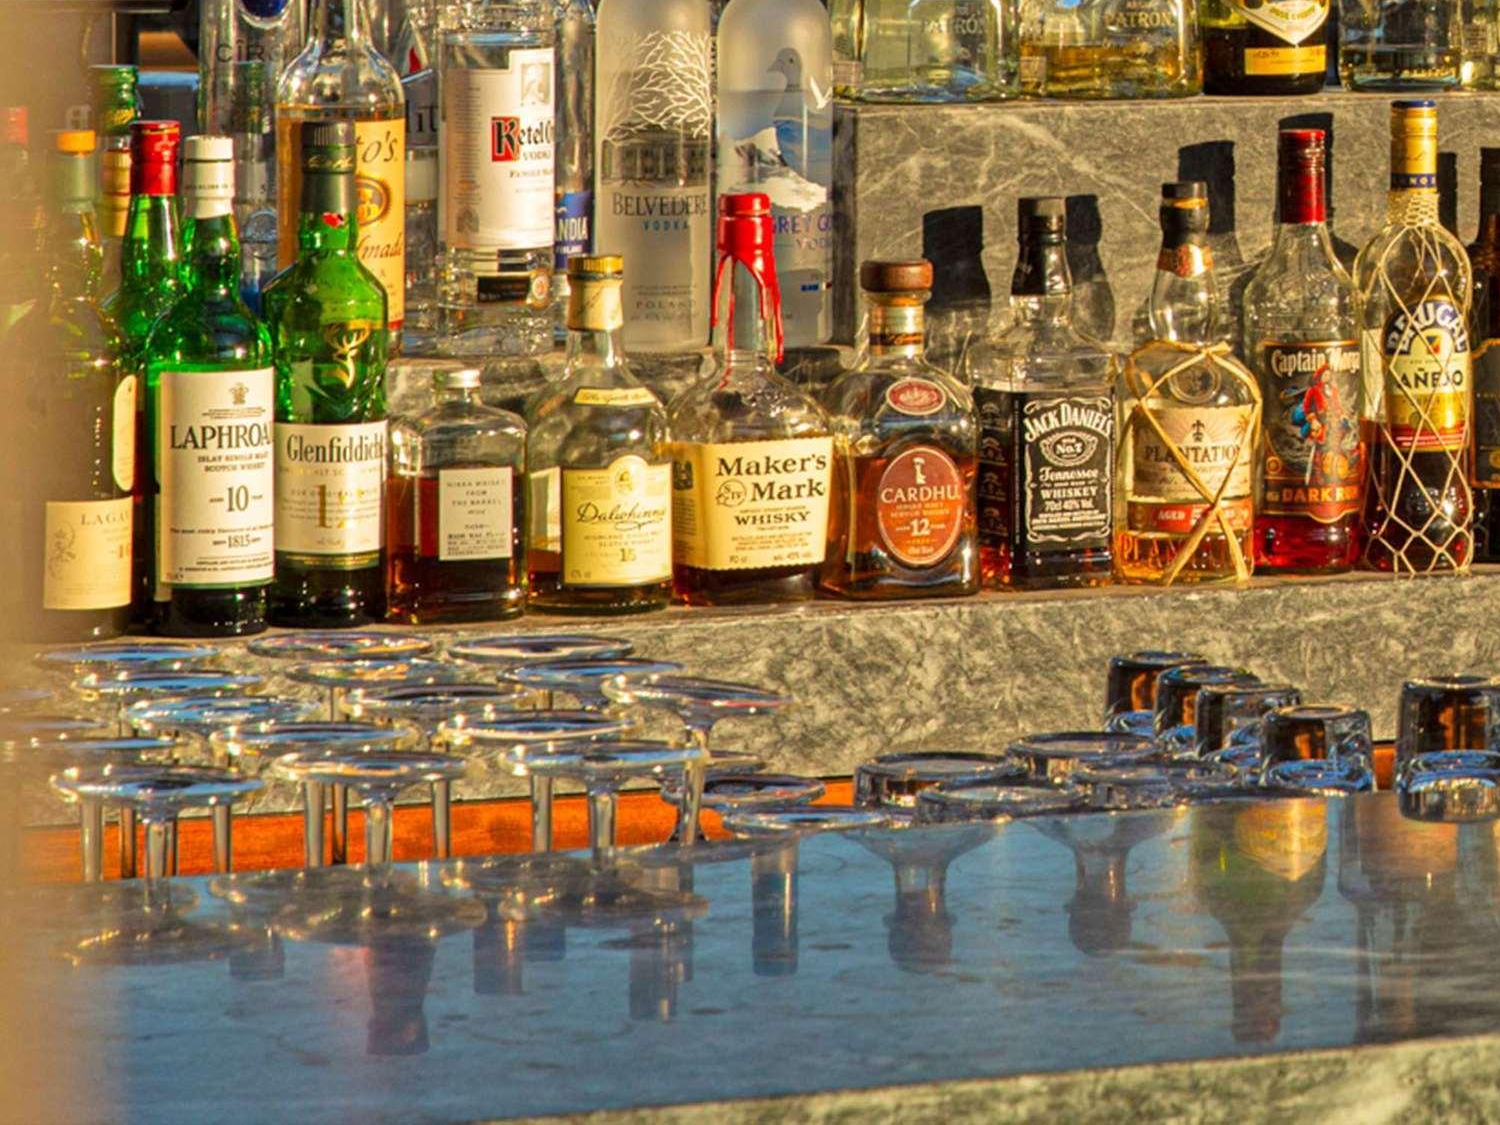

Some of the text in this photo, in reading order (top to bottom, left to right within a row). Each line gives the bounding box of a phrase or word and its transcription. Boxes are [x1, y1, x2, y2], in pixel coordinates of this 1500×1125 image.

[1271, 348, 1326, 378] Captain
[1022, 402, 1115, 443] JACK DANIEL'S
[169, 423, 273, 450] LAPHROA
[1143, 445, 1241, 464] PLANTATIO
[715, 453, 828, 477] Maker's
[226, 484, 250, 512] 10
[751, 478, 825, 503] Mark
[880, 485, 961, 504] CARDHU
[1040, 486, 1099, 499] WHISKEY
[1281, 486, 1333, 504] DARK
[734, 511, 811, 526] WHISKY
[910, 517, 931, 537] 12
[619, 547, 637, 563] 15
